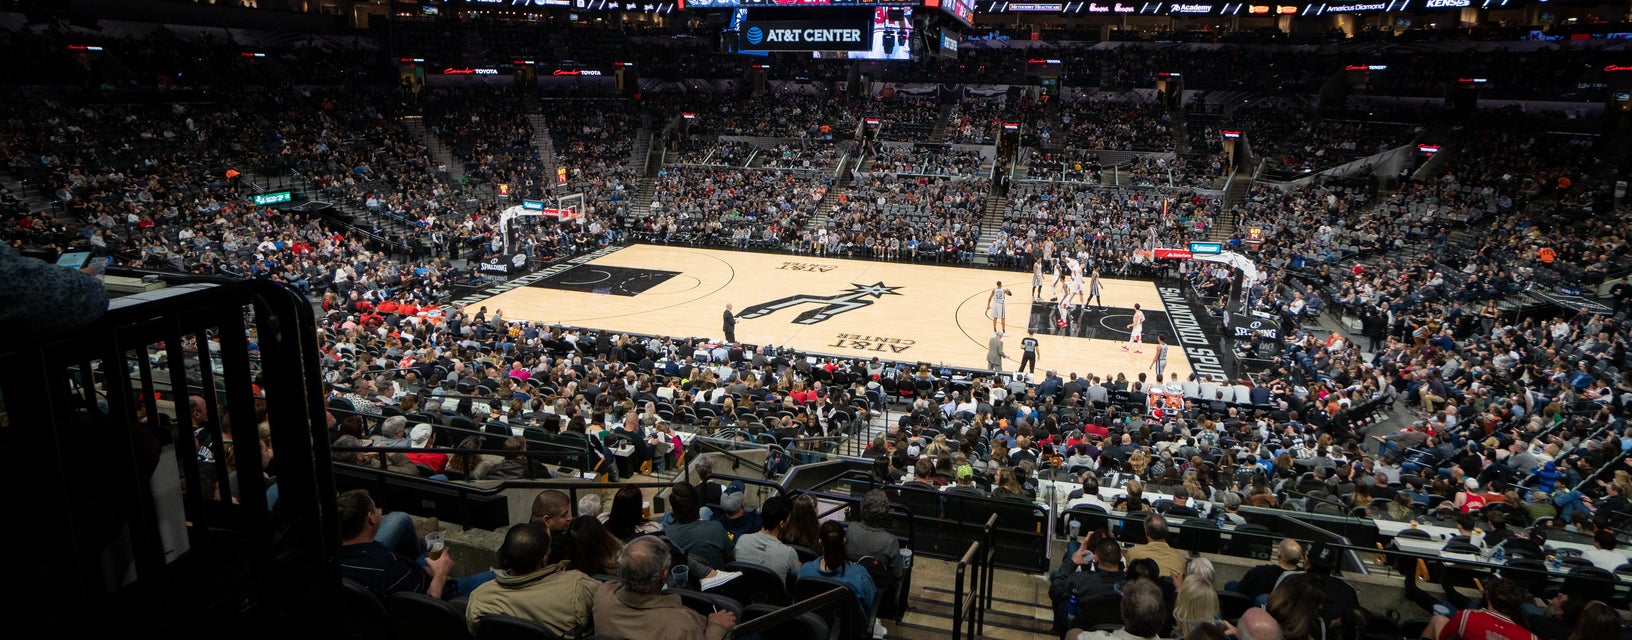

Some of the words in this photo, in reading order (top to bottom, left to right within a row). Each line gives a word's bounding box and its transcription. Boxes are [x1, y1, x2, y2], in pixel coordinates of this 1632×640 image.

[1327, 4, 1354, 12] Americus
[1355, 3, 1385, 11] Diamond
[766, 29, 801, 42] AT&T
[803, 29, 861, 42] CENTER
[481, 262, 507, 272] SPALDING
[1166, 302, 1209, 345] ANTONIO
[837, 332, 916, 345] CENTER
[828, 340, 912, 354] AT&T
[1186, 347, 1229, 383] SPUR
